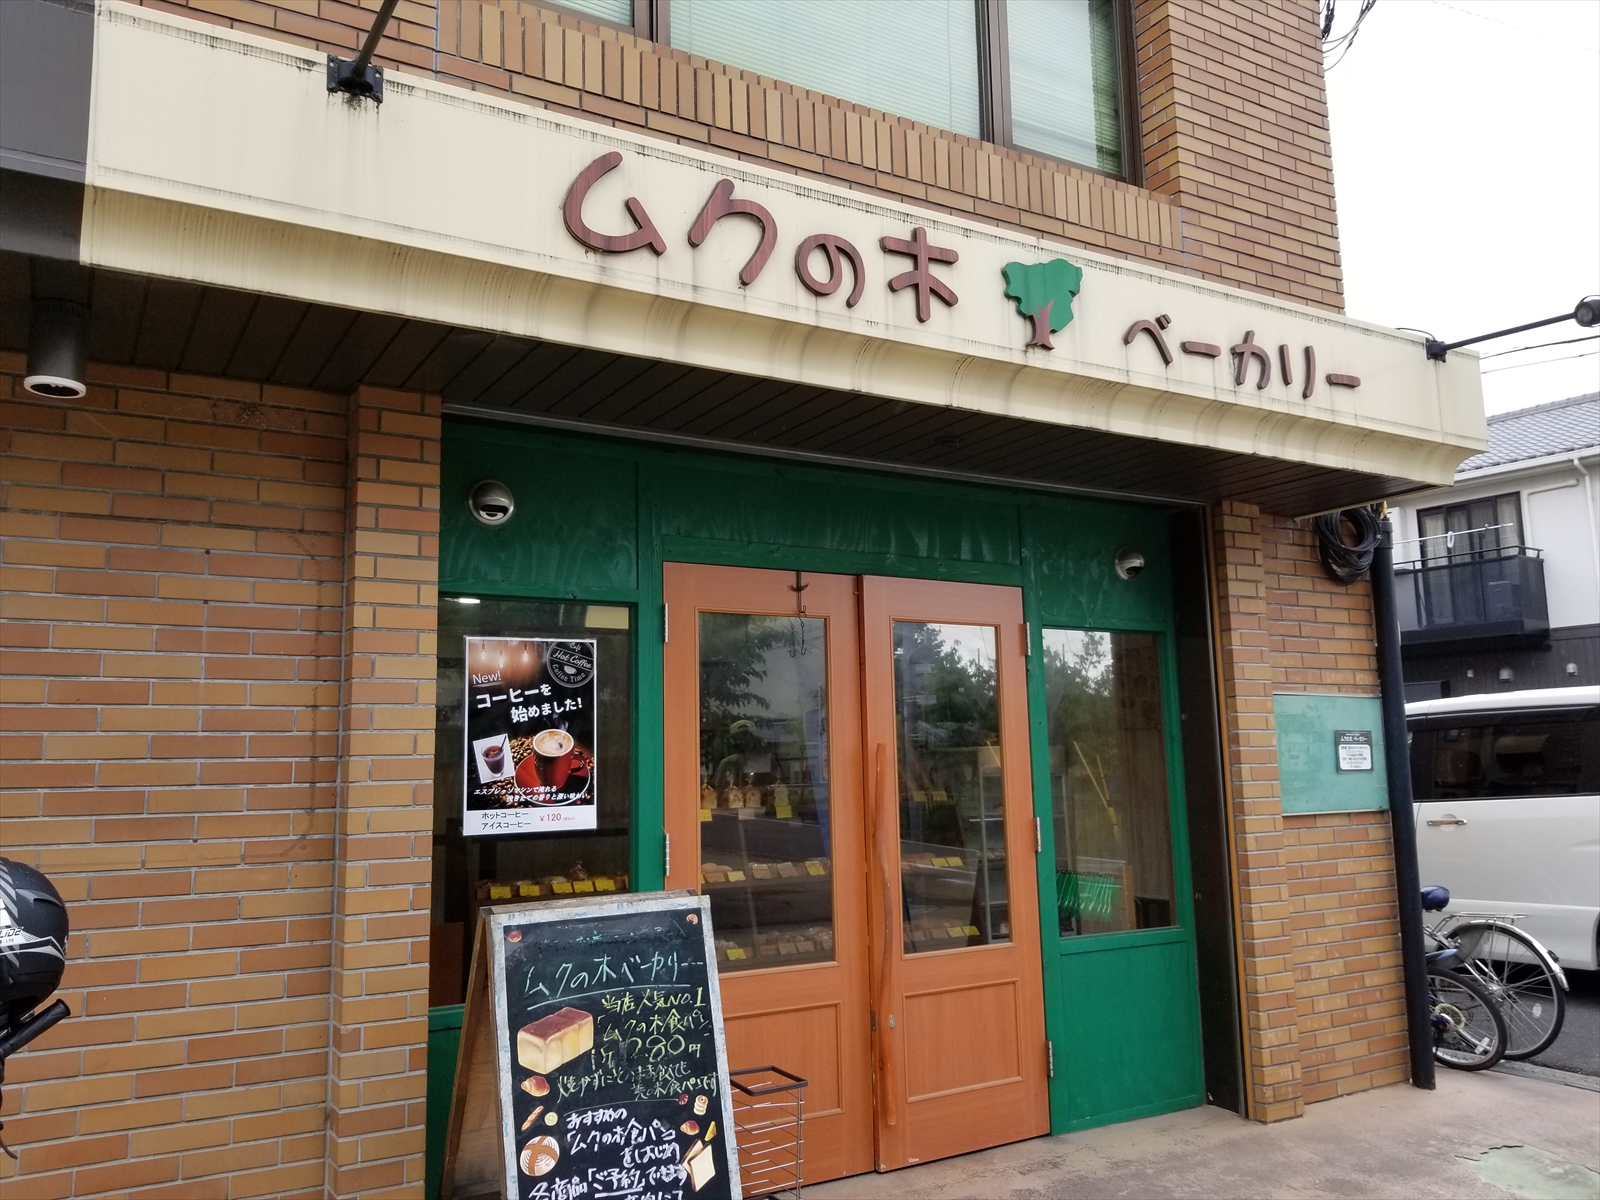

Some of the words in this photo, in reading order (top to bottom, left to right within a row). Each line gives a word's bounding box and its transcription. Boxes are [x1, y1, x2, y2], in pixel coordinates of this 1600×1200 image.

[563, 150, 960, 323] ムクの木
[1123, 313, 1362, 400] ベーカリー
[553, 650, 570, 660] Hot
[570, 655, 592, 668] Coffee
[472, 671, 502, 684] New!
[476, 684, 552, 709] コーヒーを
[481, 811, 529, 820] ホットコーヒー
[482, 821, 531, 830] アイスコーヒー
[524, 951, 704, 998] ムクの木ベーカリー
[566, 1108, 628, 1130] おすすめの
